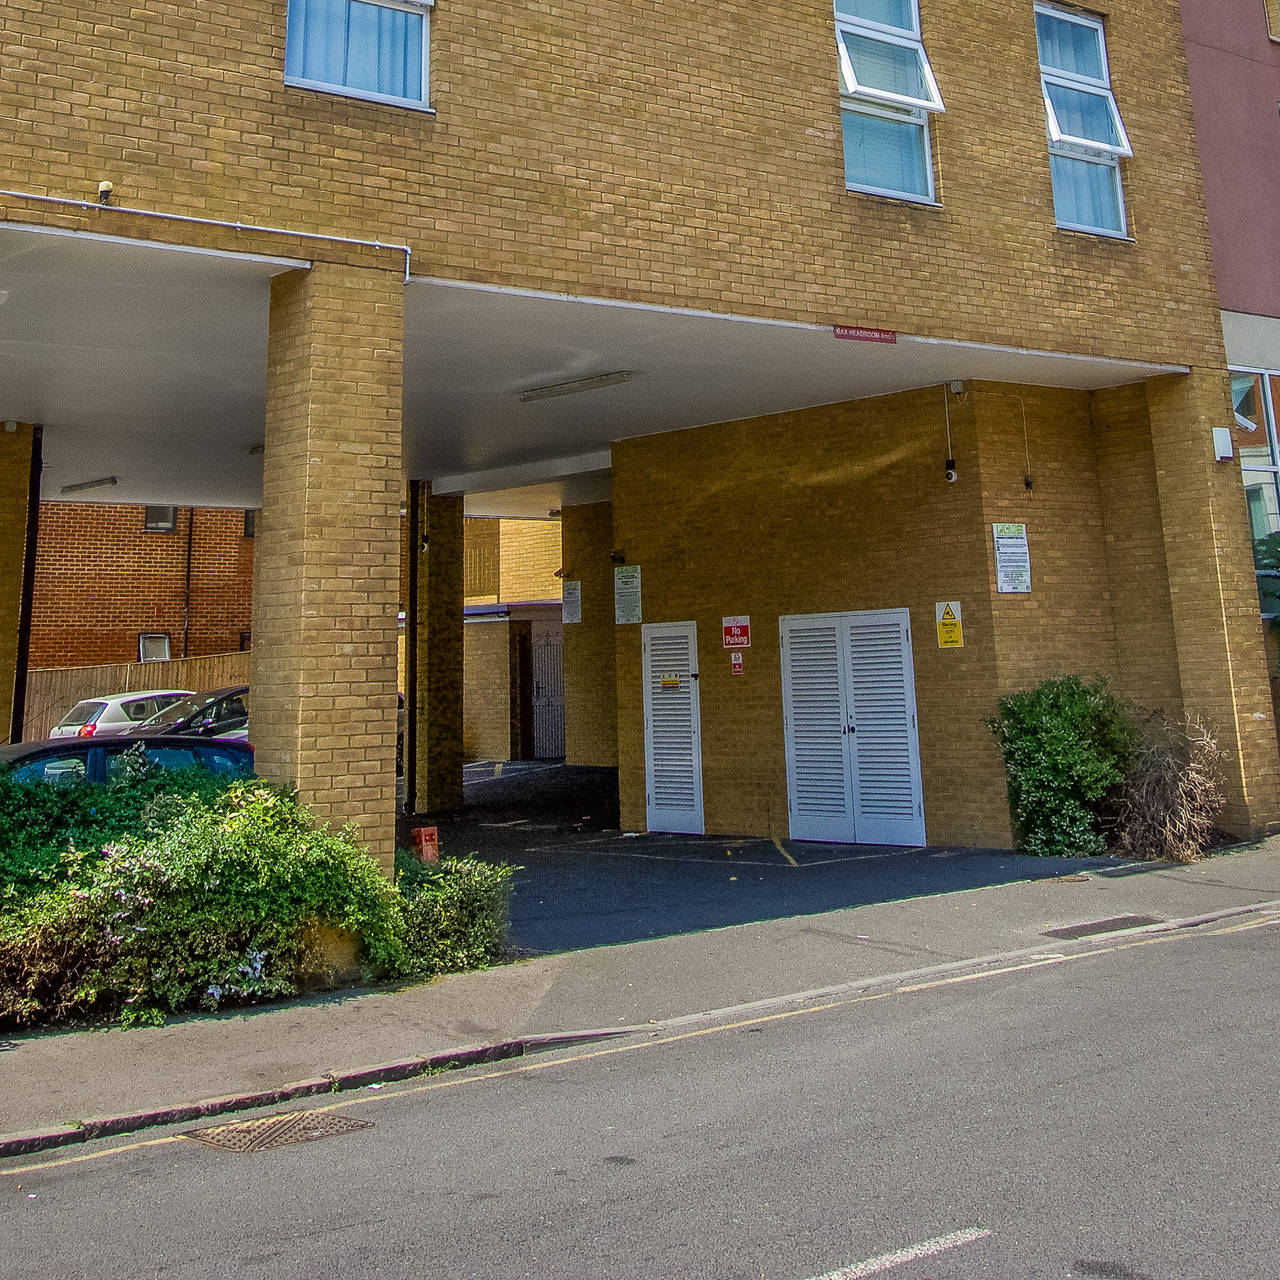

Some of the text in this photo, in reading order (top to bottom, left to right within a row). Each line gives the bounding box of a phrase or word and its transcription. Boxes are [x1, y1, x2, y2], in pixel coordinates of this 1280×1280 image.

[848, 329, 880, 338] HEADROOM
[732, 626, 740, 634] No
[726, 635, 748, 644] Parking
